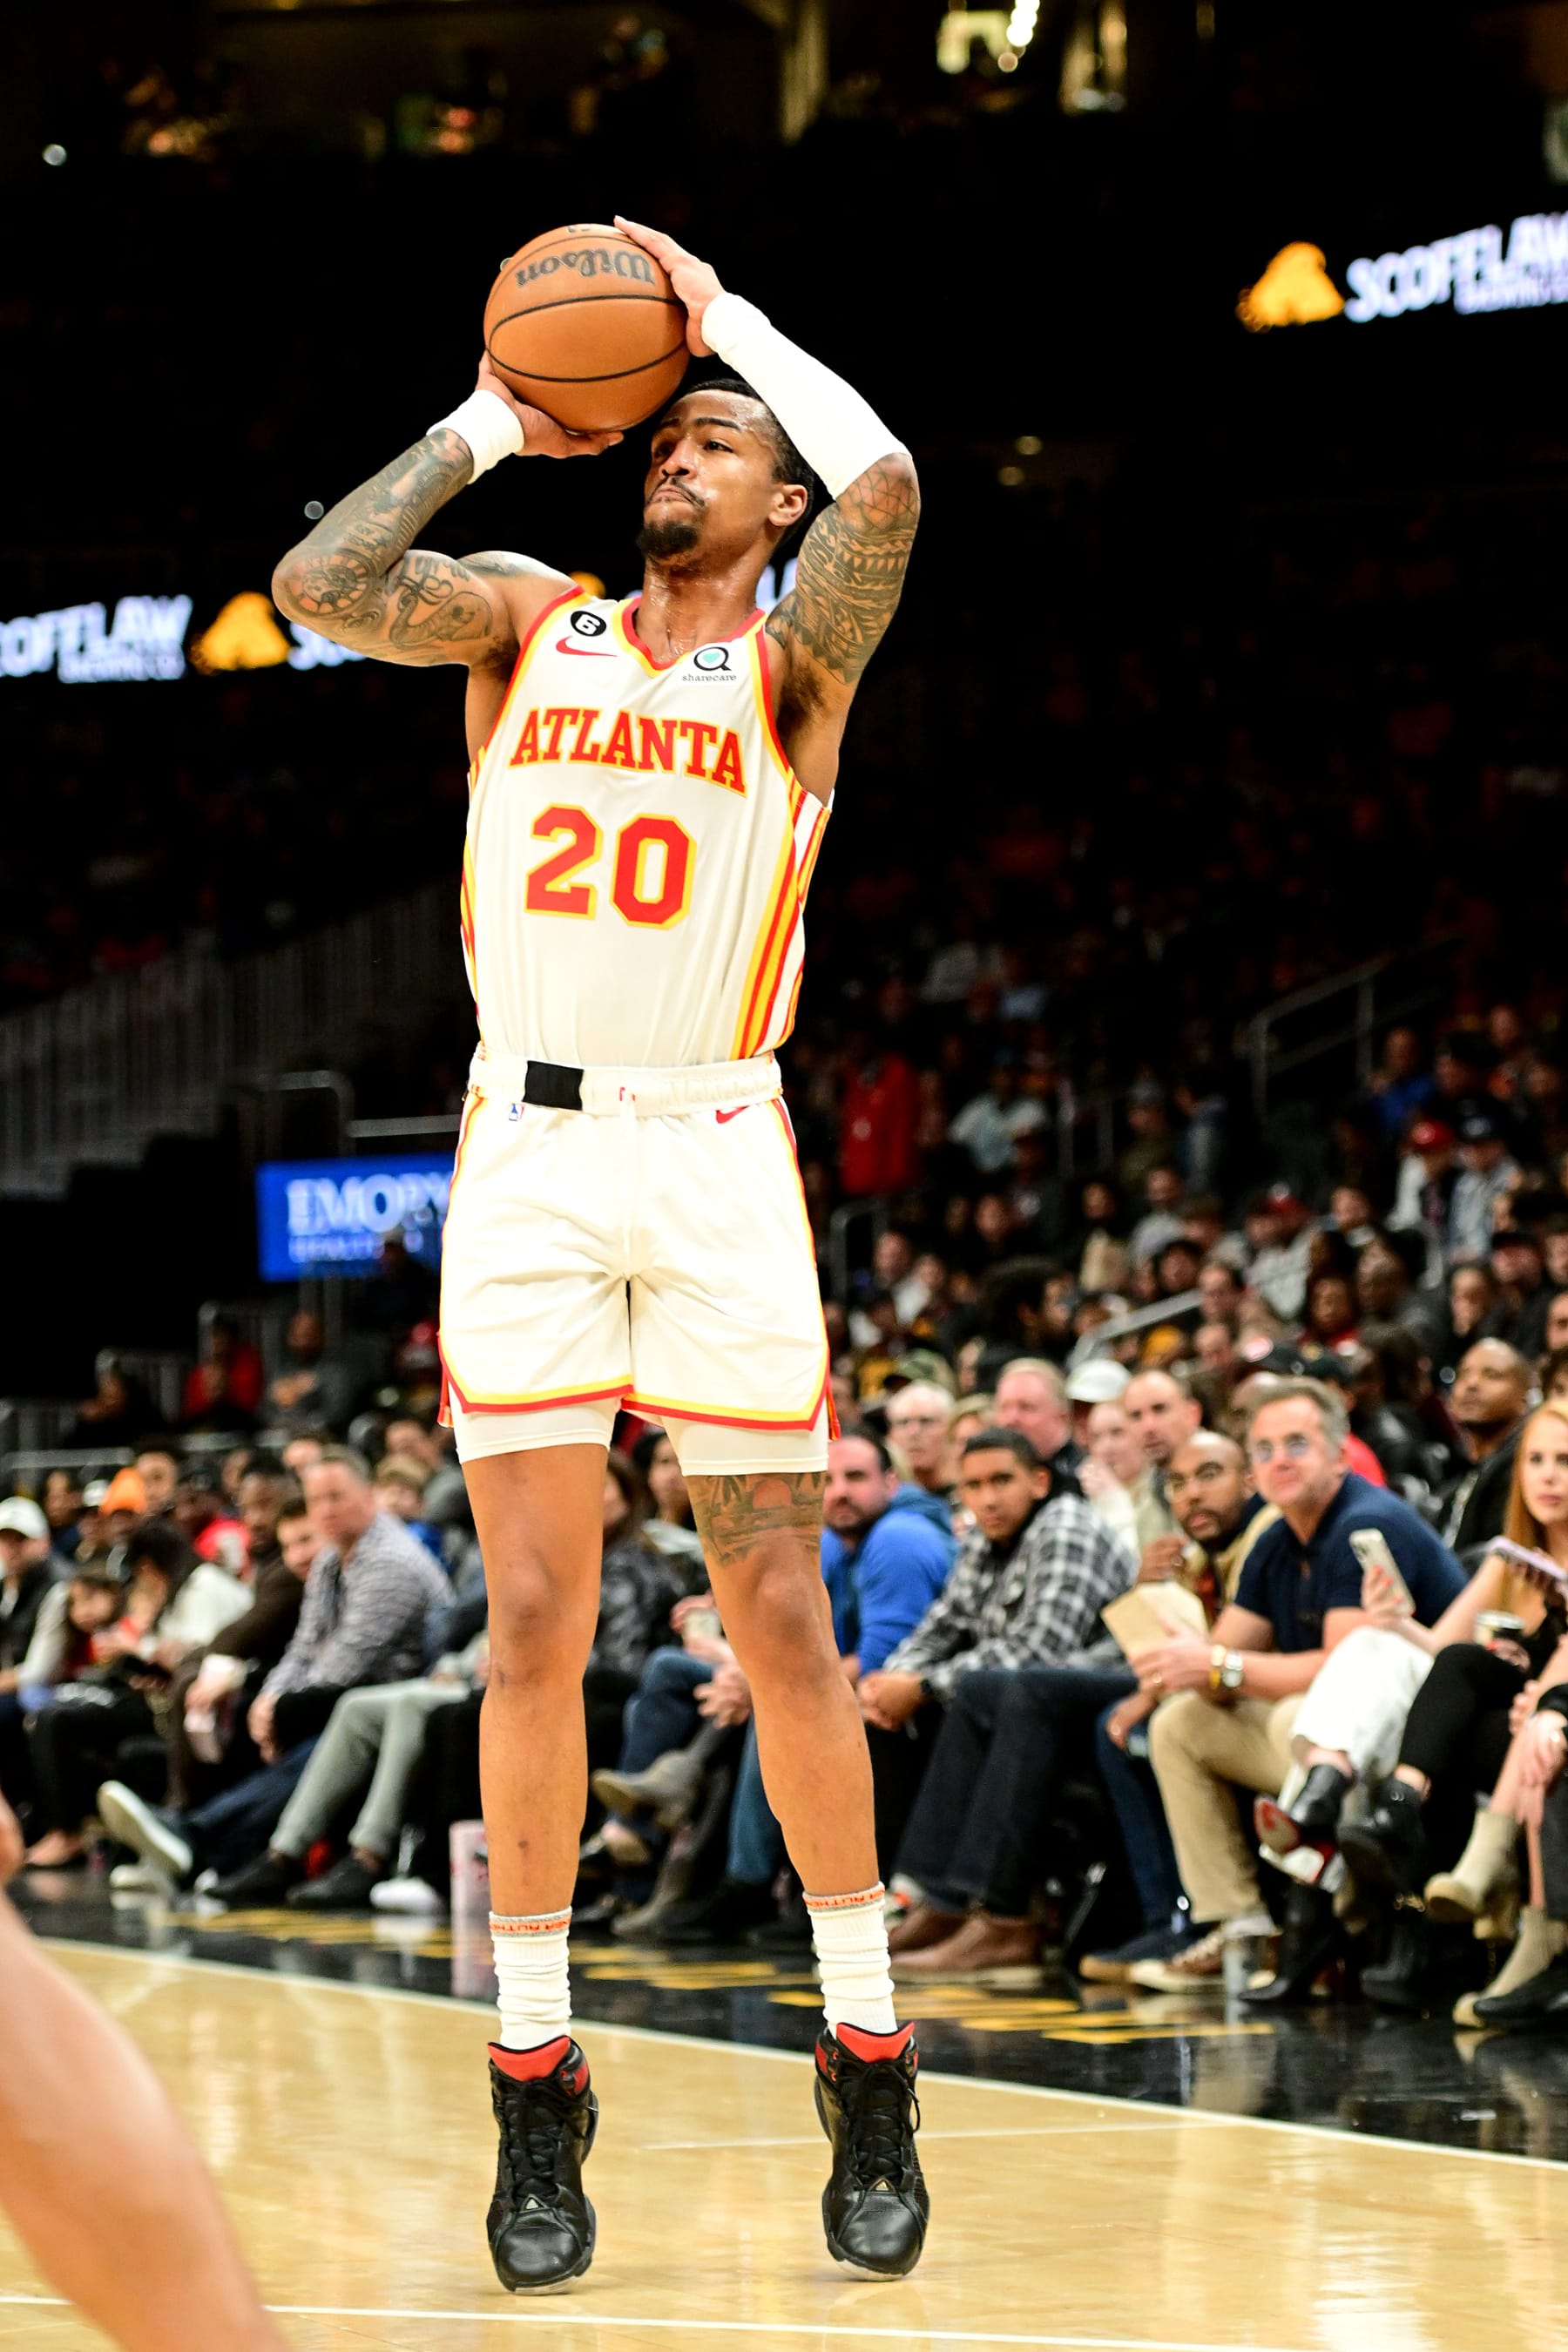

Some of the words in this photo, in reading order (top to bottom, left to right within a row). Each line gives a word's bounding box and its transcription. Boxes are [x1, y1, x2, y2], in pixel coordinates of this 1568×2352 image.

[515, 247, 656, 289] Wilson
[0, 594, 193, 677] OFFLAW
[574, 613, 602, 635] 6
[682, 672, 737, 682] sharecare
[508, 706, 747, 798] ATLANTA
[524, 802, 697, 930] 20
